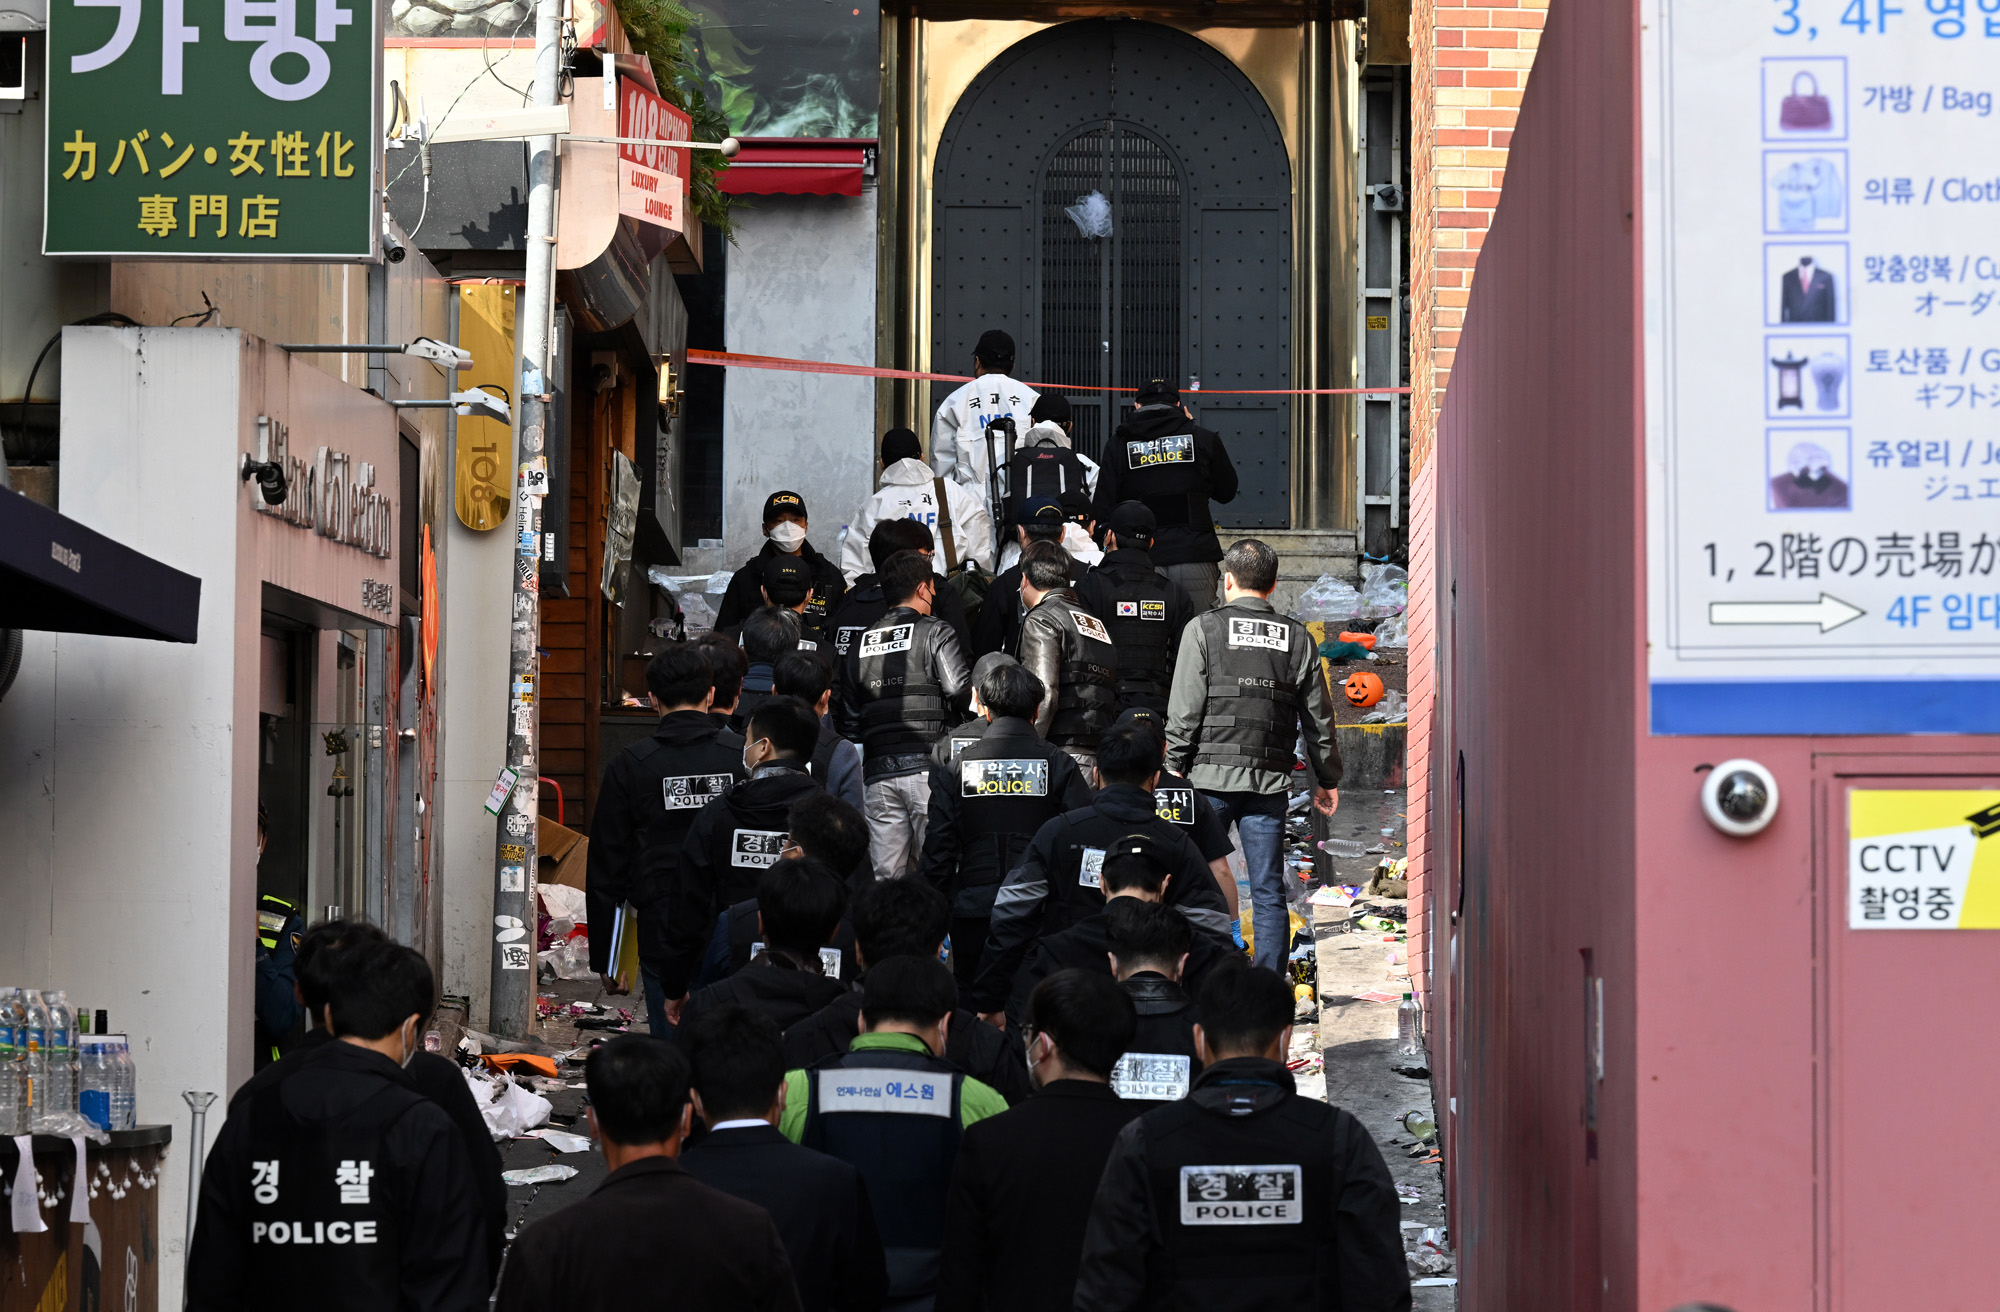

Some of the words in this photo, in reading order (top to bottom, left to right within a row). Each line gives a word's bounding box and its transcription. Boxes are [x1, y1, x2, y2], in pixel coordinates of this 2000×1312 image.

[71, 0, 353, 101] 가방
[1863, 85, 1914, 113] 가방
[1943, 86, 1992, 117] Bag
[626, 89, 658, 168] 108
[62, 128, 355, 181] カバン・女性化
[658, 146, 679, 177] CLUB
[631, 170, 659, 193] LUXURY
[1864, 177, 1915, 205] 의류
[645, 198, 673, 221] LOUNGE
[1865, 255, 1952, 283] 맞춤양복
[1915, 291, 2000, 316] オーダ
[1866, 348, 1950, 375] 토산품
[1132, 437, 1188, 454] 과학수사
[1140, 451, 1183, 464] POLICE
[1867, 440, 1949, 468] 쥬얼리
[470, 441, 497, 503] 108
[315, 445, 391, 560] Collection
[517, 506, 527, 544] Helinox
[1886, 595, 1931, 628] 4F
[868, 627, 907, 644] 경찰
[1081, 627, 1107, 640] POLICE
[1237, 621, 1282, 638] 경찰
[1237, 636, 1282, 647] POLICE
[866, 641, 905, 653] POLICE
[870, 676, 904, 688] POLICE
[1088, 663, 1110, 677] POLICE
[1238, 677, 1275, 688] POLICE
[673, 777, 724, 795] 경찰
[977, 781, 1032, 793] POLICE
[1859, 845, 1955, 874] CCTV
[1859, 886, 1954, 921] 촬영중
[886, 1082, 934, 1100] 에스원
[251, 1160, 375, 1205] 경찰
[1198, 1173, 1286, 1201] 경찰
[1196, 1205, 1287, 1219] POLICE
[252, 1221, 378, 1244] POLICE
